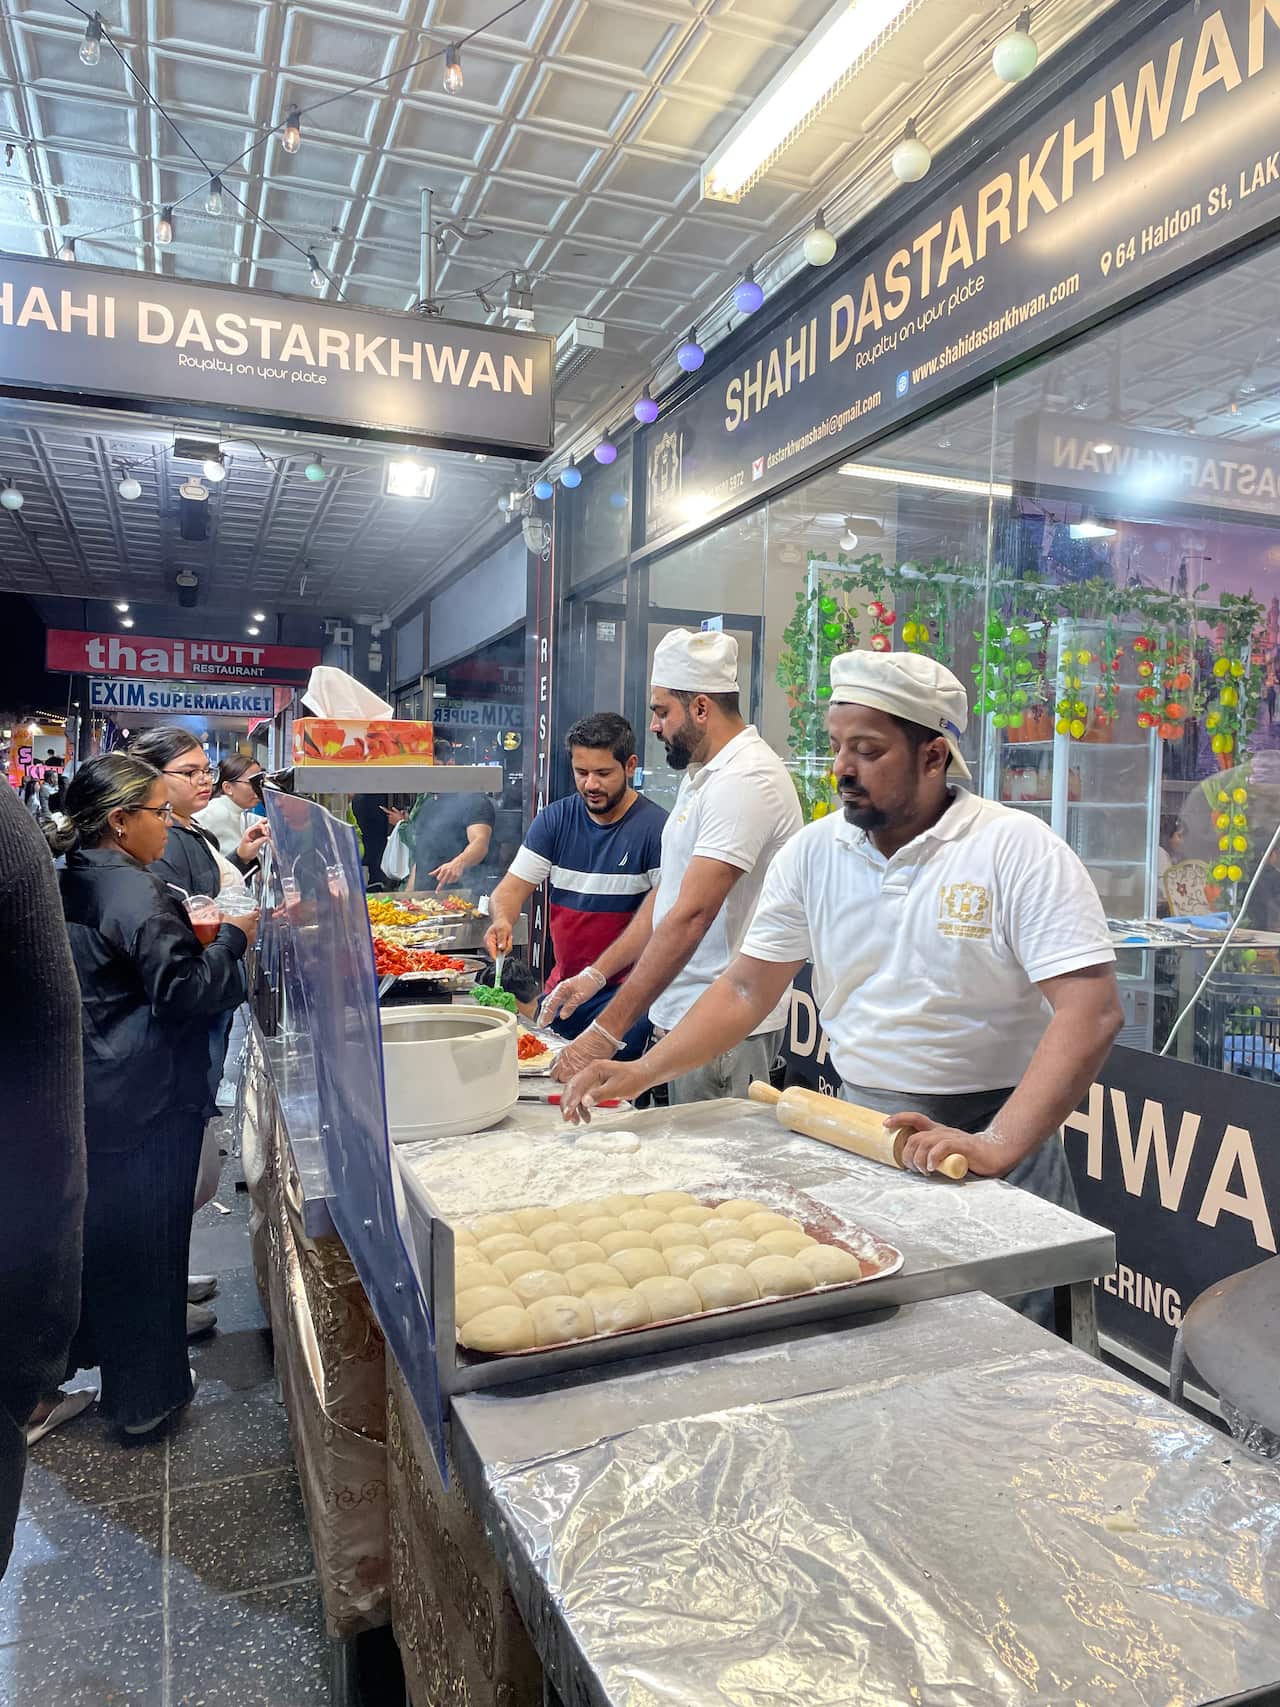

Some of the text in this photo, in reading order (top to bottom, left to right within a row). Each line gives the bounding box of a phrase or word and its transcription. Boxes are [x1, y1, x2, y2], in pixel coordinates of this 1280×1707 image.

[911, 273, 1080, 385] www.shahidastarkhwan.com
[1115, 236, 1136, 269] 64
[1140, 202, 1202, 256] Haldon
[1207, 182, 1233, 217] St,
[138, 301, 534, 396] DASTARKHWAN
[855, 275, 985, 371] Royalty on your plate
[179, 353, 328, 385] Royalty on your plate
[725, 318, 817, 432] SHAHI
[85, 638, 265, 674] thai HUTT
[192, 663, 265, 677] RESTAURANT
[91, 682, 146, 707] EXIM
[149, 692, 272, 712] SUPERMARKET
[1094, 1263, 1182, 1328] ERING
